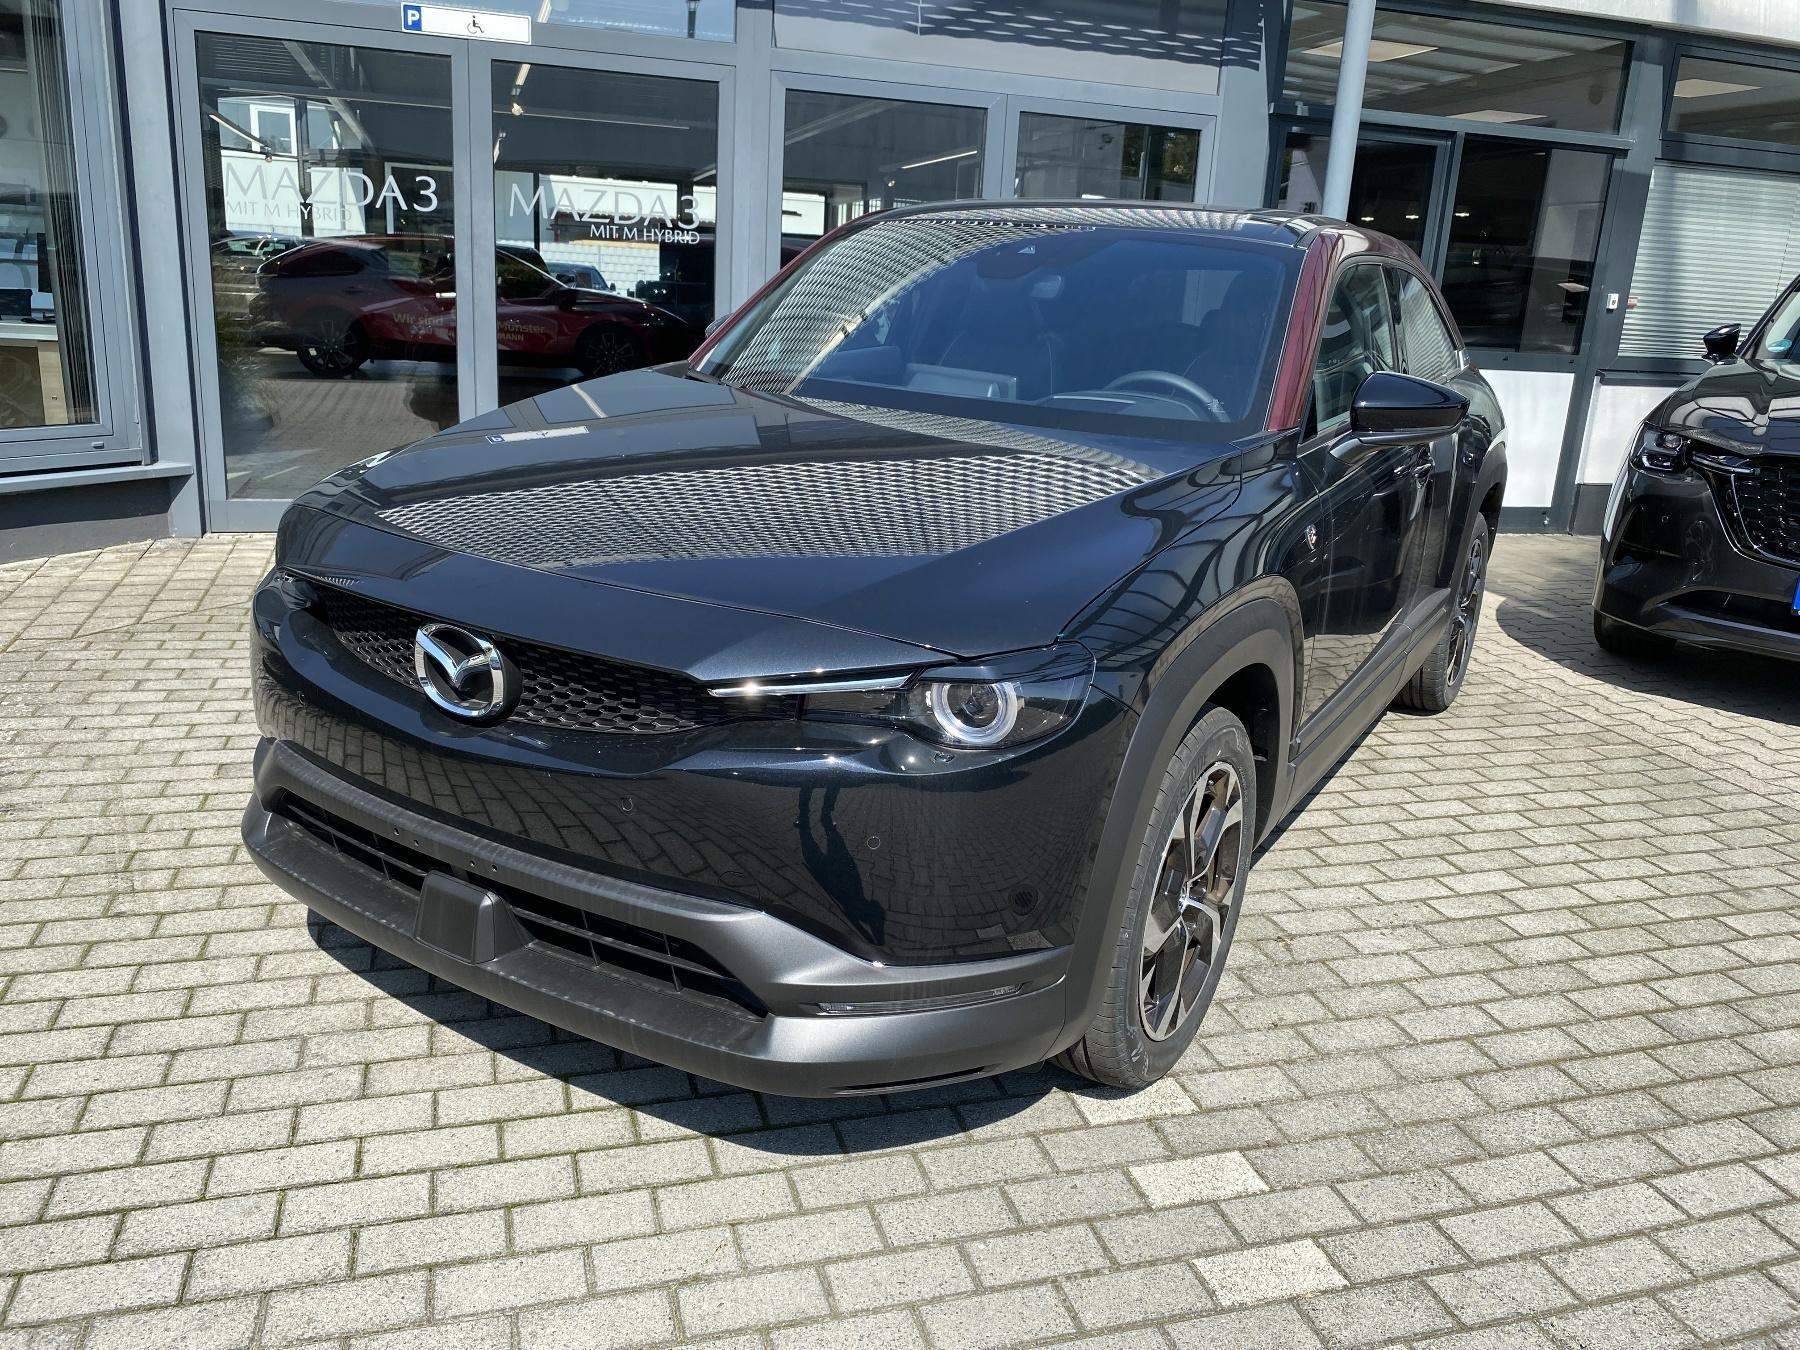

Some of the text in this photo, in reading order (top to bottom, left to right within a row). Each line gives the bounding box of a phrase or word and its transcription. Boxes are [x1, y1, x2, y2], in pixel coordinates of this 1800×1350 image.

[407, 9, 420, 26] P
[226, 201, 352, 222] MIT M HYBRID
[590, 224, 700, 245] MIT M HYBRID
